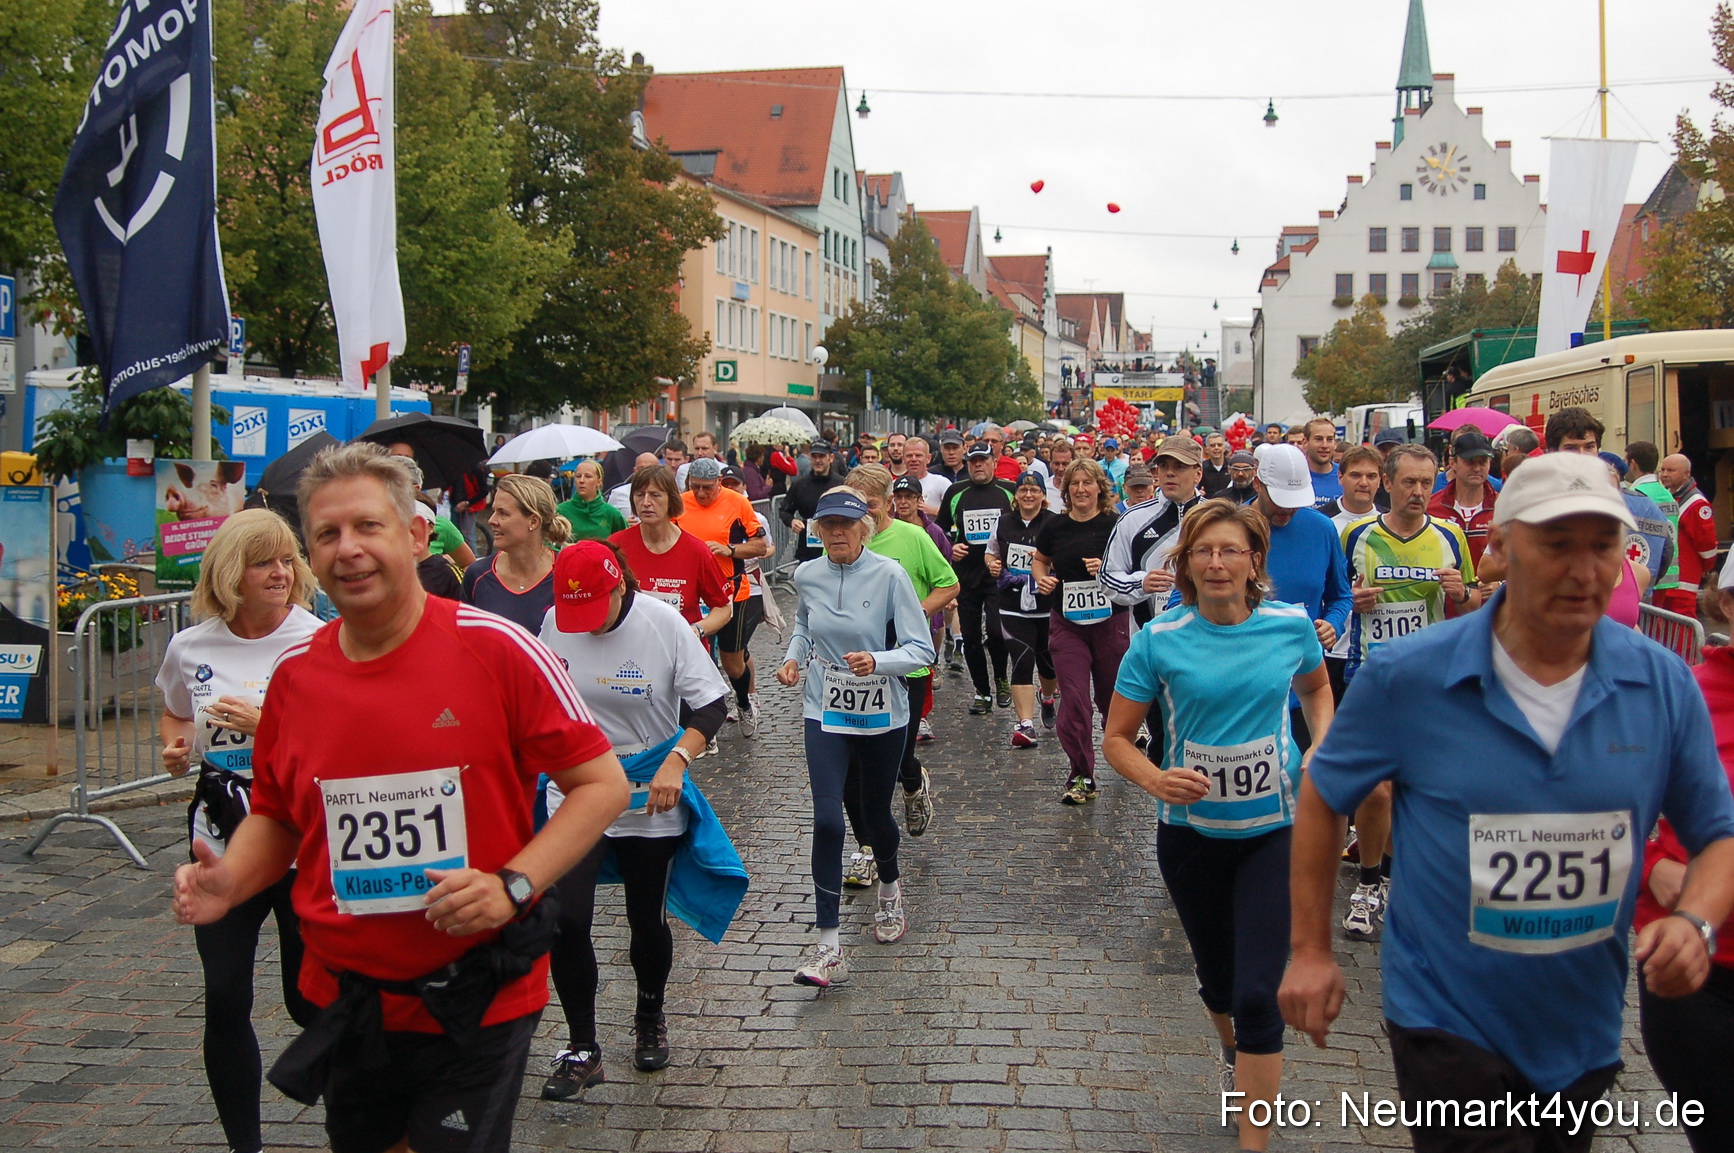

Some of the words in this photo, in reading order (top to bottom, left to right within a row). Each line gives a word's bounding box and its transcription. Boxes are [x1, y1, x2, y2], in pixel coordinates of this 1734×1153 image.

[231, 322, 242, 349] P
[461, 350, 468, 370] P
[717, 363, 735, 380] D
[1122, 390, 1154, 399] START
[1549, 385, 1600, 411] Bayerisches
[164, 533, 188, 544] BEIDE
[562, 592, 593, 600] FOREVER
[1067, 591, 1106, 609] 2015
[1386, 607, 1417, 615] Neumarkt
[1371, 615, 1423, 640] 3103
[825, 675, 845, 686] PARTL
[829, 686, 885, 712] 2974
[432, 719, 461, 729] adidas
[844, 716, 868, 726] Heidi
[1185, 749, 1214, 763] PARTL
[1216, 749, 1262, 763] Neumarkt
[325, 792, 365, 806] PARTL
[368, 786, 435, 804] Neumarkt
[337, 803, 447, 862] 2351
[1473, 829, 1528, 842] PARTL
[1531, 828, 1605, 842] Neumarkt
[1488, 847, 1611, 902] 2251
[1503, 914, 1595, 938] Wolfgang
[441, 1119, 469, 1131] adidas
